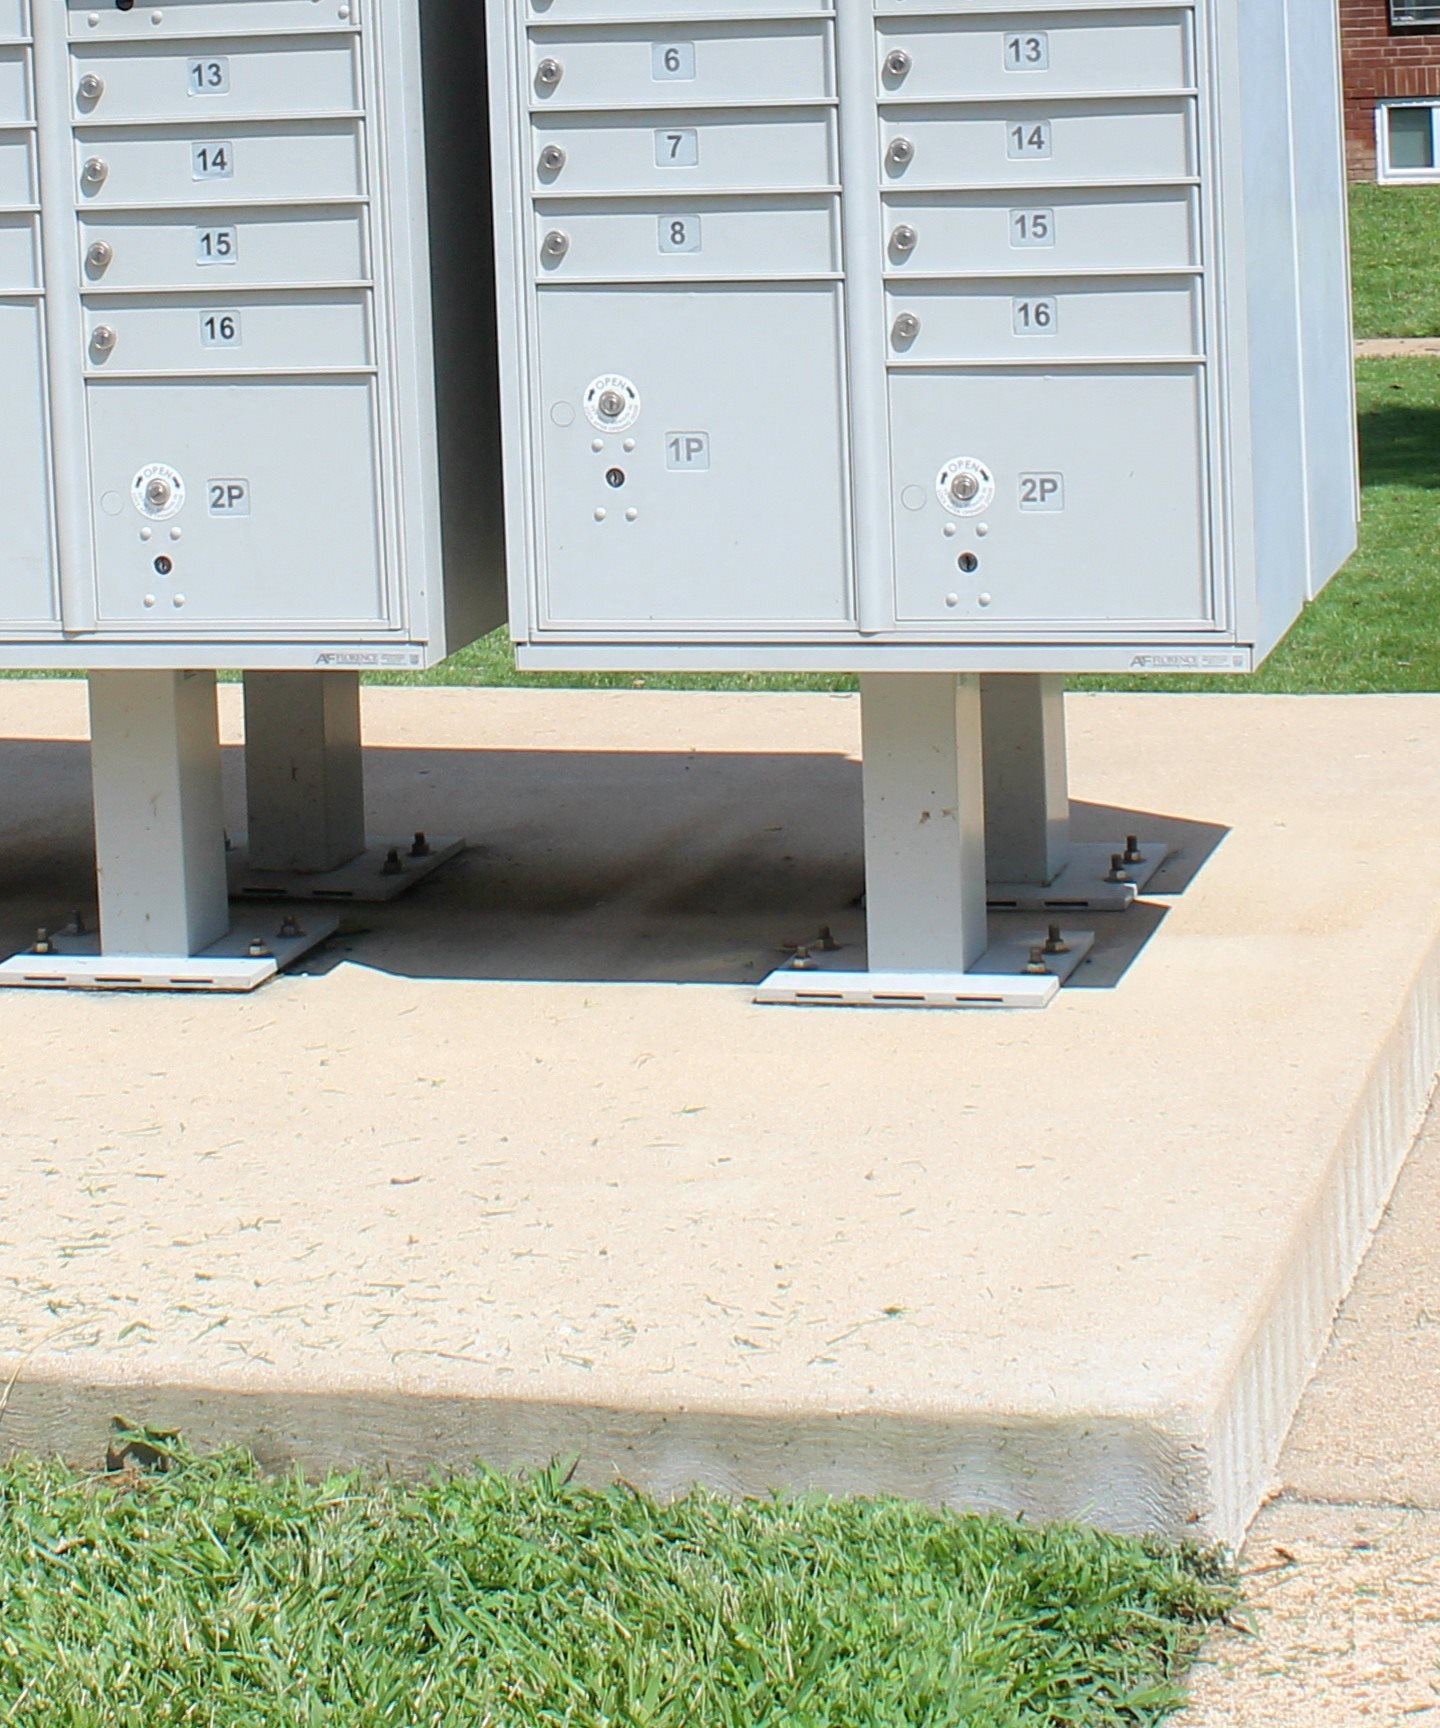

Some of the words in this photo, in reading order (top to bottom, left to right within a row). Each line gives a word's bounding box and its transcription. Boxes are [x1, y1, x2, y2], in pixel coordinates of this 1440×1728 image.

[664, 48, 680, 72] 6
[1008, 37, 1041, 62] 13
[191, 63, 222, 87] 13
[666, 135, 682, 158] 7
[1011, 125, 1045, 150] 14
[196, 148, 227, 171] 14
[670, 221, 686, 245] 8
[1014, 214, 1048, 239] 15
[200, 232, 231, 256] 15
[1017, 302, 1050, 327] 16
[204, 316, 235, 340] 16
[595, 377, 626, 390] OPEN
[668, 437, 704, 462] 1P
[143, 466, 172, 478] OPEN
[948, 460, 979, 473] OPEN
[210, 485, 244, 509] 2P
[1020, 478, 1058, 503] 2P
